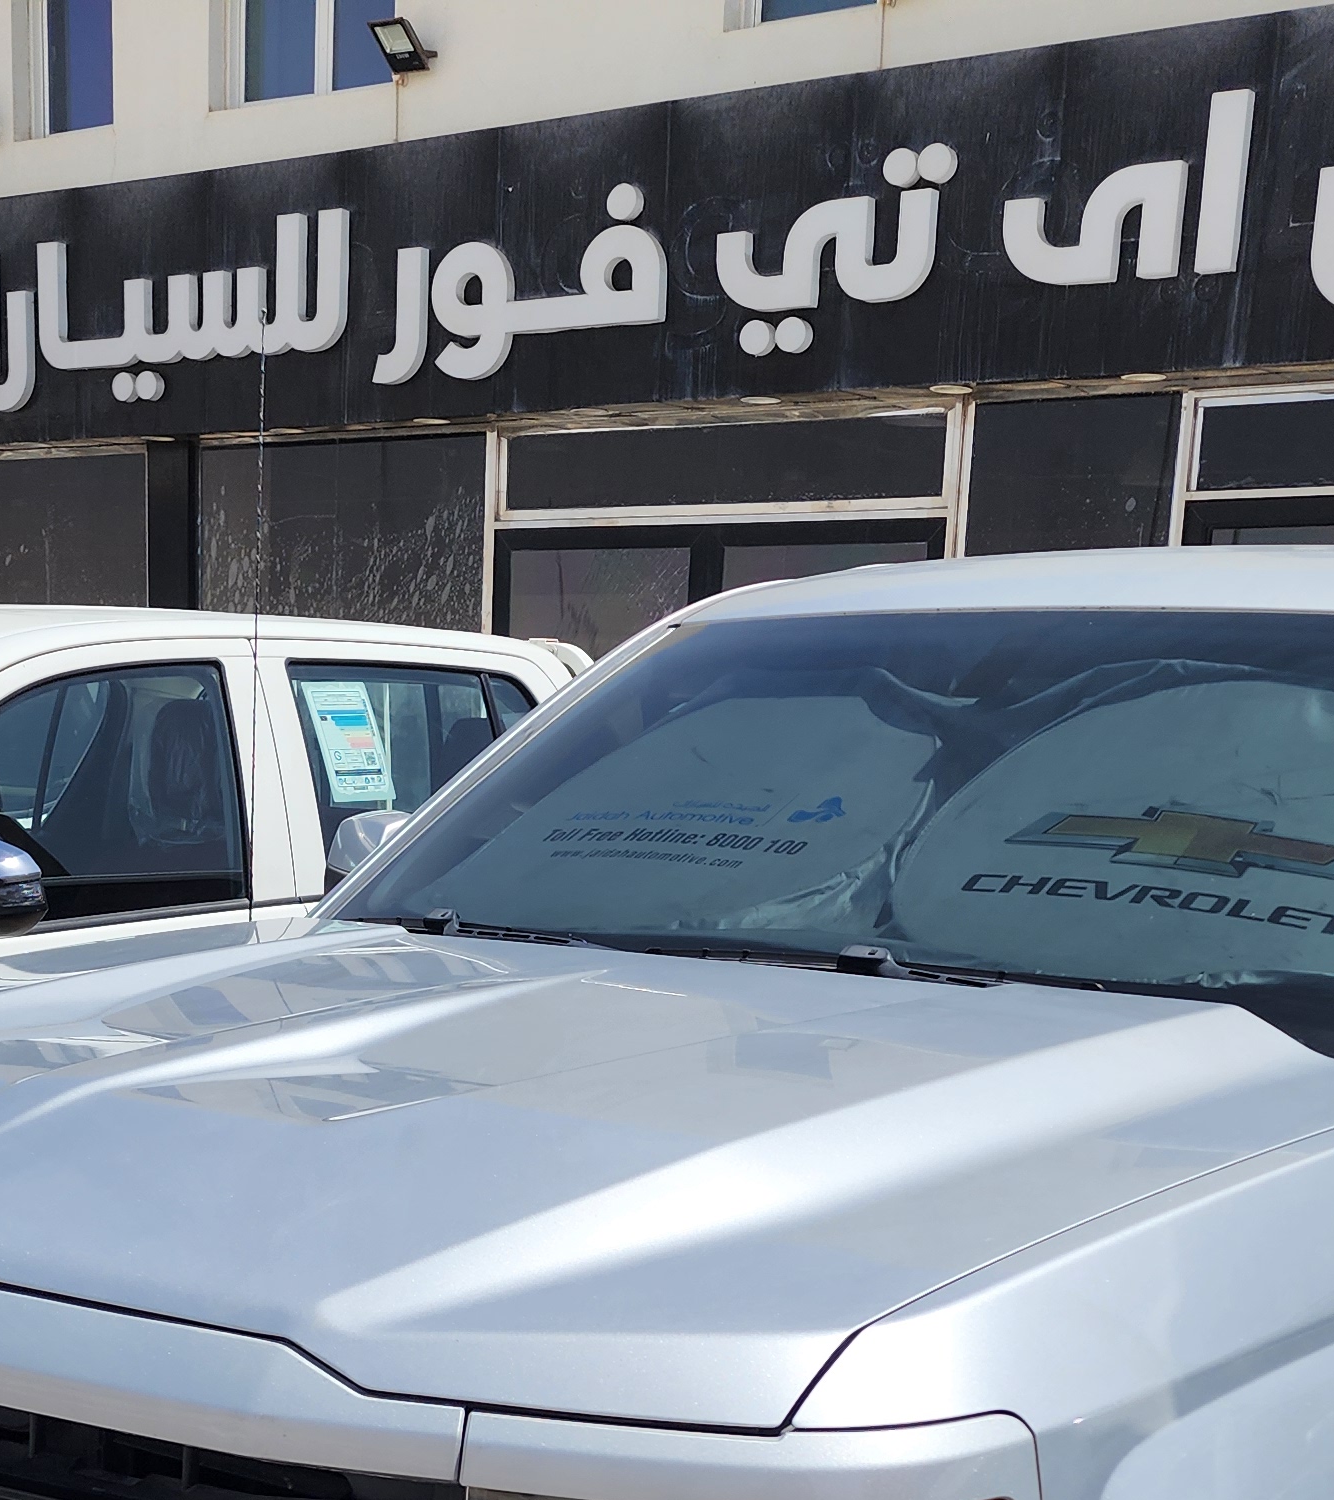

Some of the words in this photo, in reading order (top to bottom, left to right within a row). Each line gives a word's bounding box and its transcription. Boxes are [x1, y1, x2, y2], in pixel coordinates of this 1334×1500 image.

[371, 182, 668, 385] فور
[715, 142, 958, 358] تي
[542, 828, 584, 842] Toll
[577, 828, 625, 842] Free
[622, 828, 707, 846] Hotline:
[705, 833, 765, 851] 8000
[763, 839, 809, 855] 100
[565, 809, 630, 822] Jaidah
